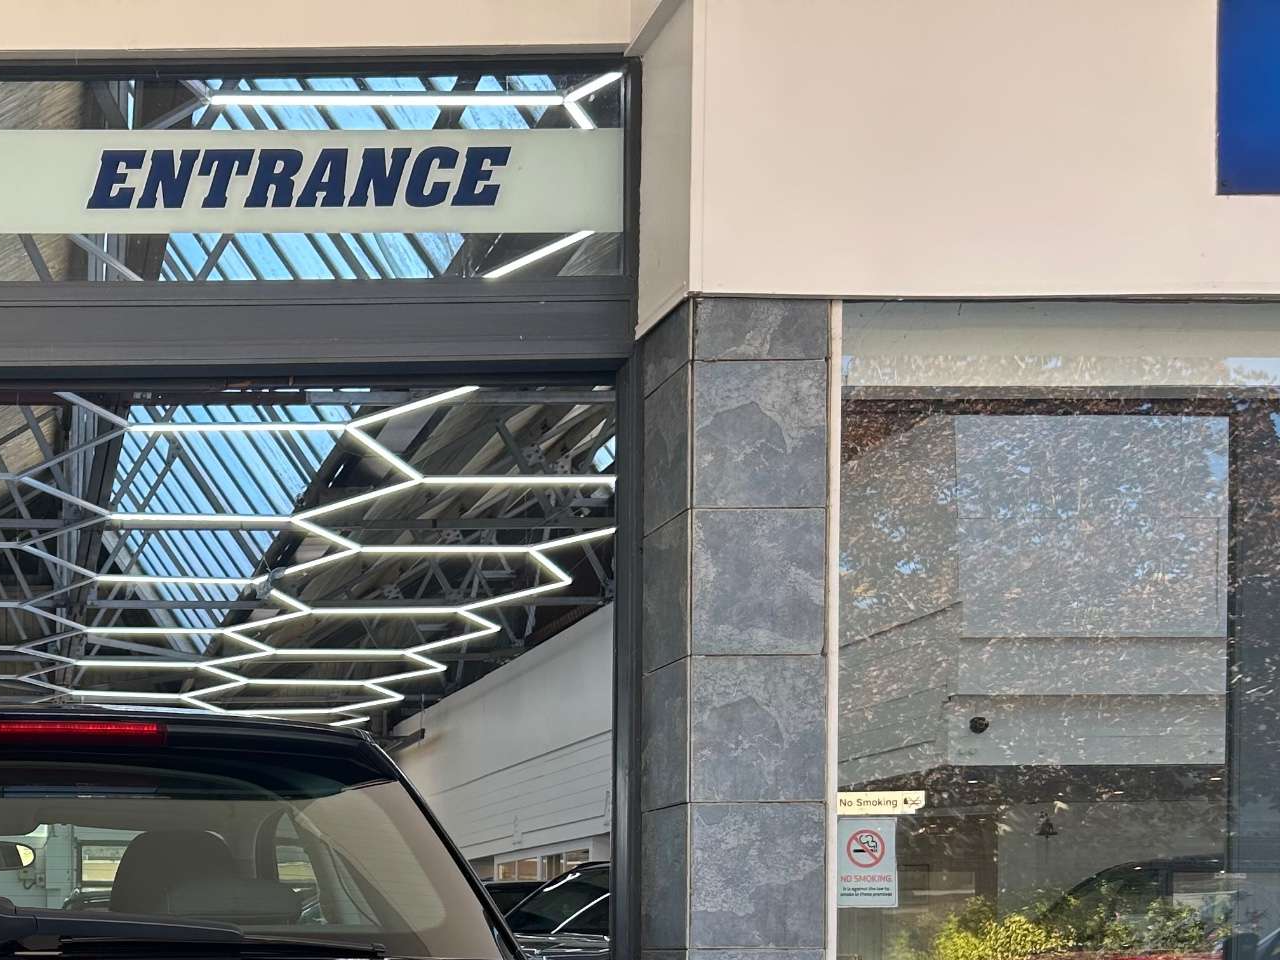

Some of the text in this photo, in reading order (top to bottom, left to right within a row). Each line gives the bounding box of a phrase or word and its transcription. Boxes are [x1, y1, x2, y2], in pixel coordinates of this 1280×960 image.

[86, 146, 512, 210] ENTRANCE
[839, 798, 898, 809] No Smoking
[840, 874, 892, 883] NO SMOKING
